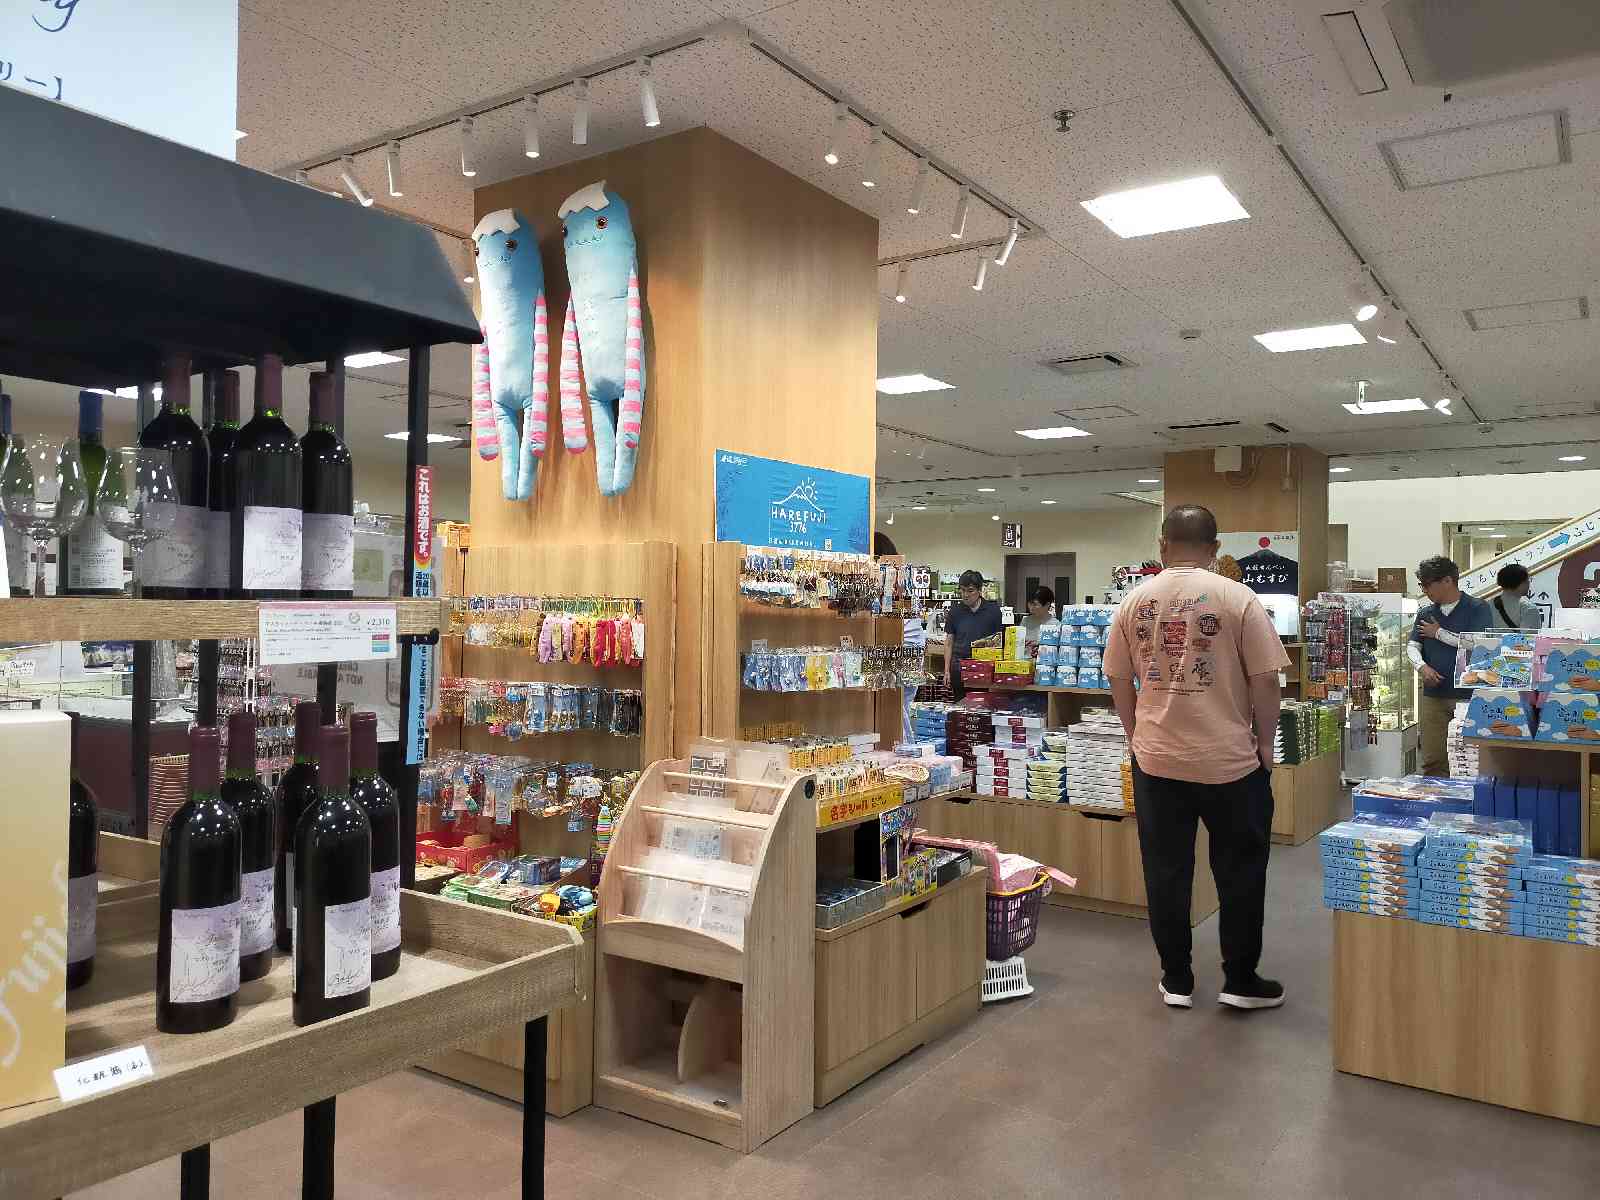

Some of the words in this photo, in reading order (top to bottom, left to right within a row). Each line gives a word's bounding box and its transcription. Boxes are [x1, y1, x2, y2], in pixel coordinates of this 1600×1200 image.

[417, 467, 430, 557] これはお酒です。
[771, 506, 826, 524] HAREFUJI
[789, 521, 807, 534] 3776
[1242, 573, 1289, 583] 山むすび
